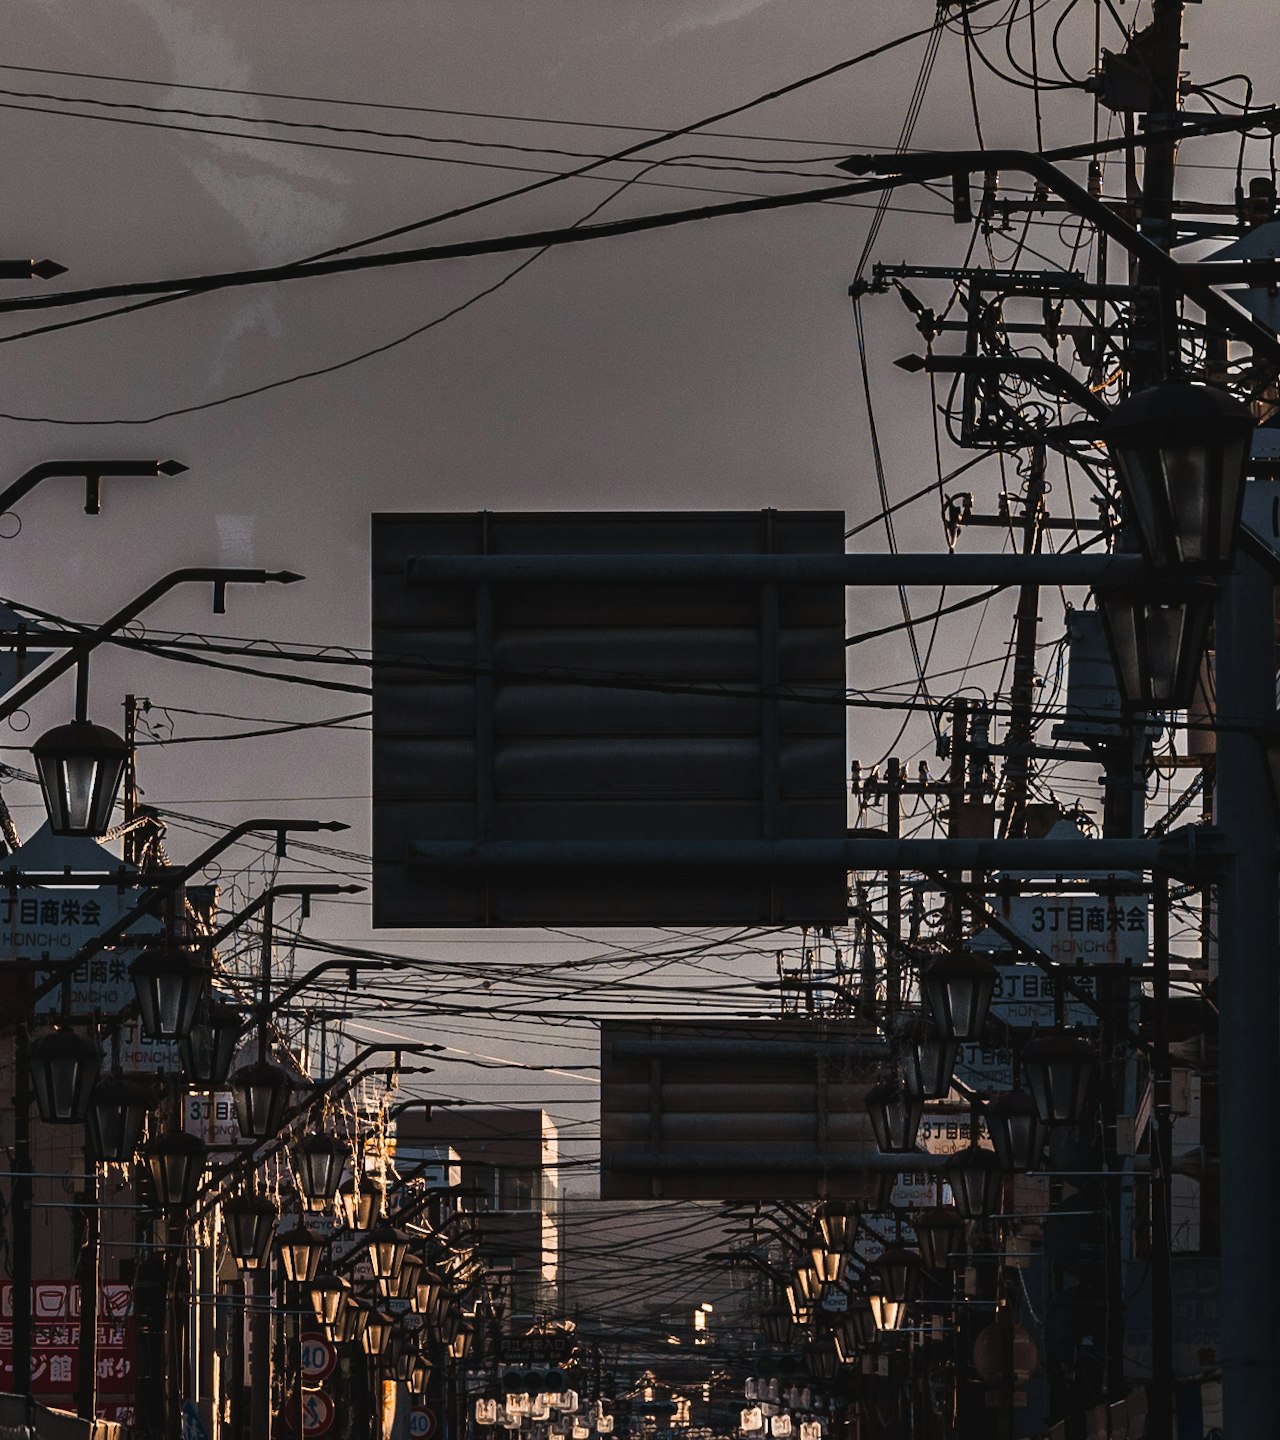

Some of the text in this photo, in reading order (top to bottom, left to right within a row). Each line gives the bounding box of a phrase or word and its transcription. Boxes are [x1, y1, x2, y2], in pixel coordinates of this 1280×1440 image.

[1031, 906, 1146, 933] 3丁目商栄会
[301, 1346, 326, 1369] 40
